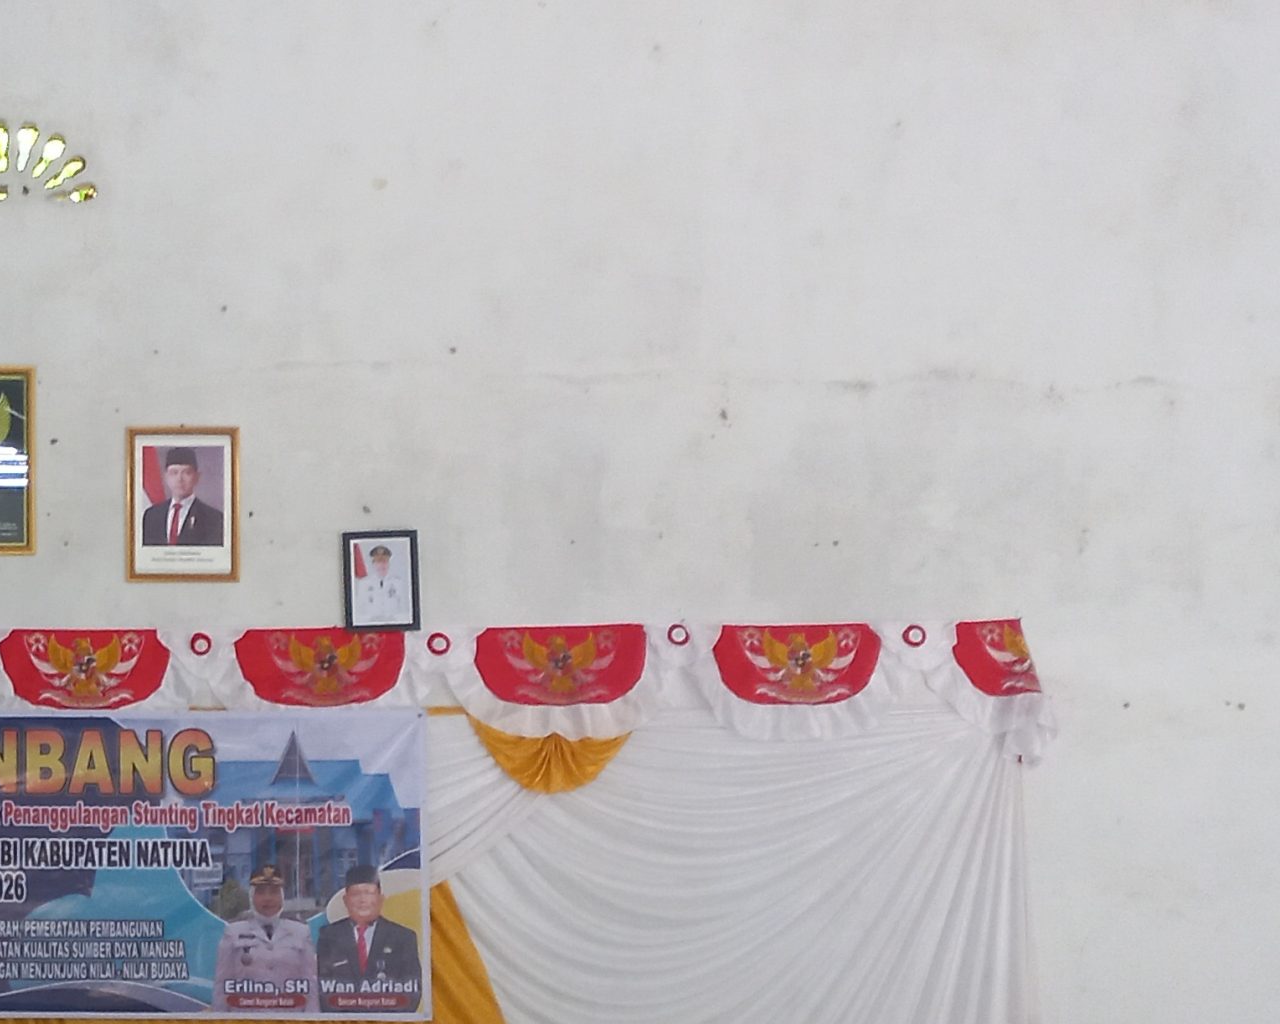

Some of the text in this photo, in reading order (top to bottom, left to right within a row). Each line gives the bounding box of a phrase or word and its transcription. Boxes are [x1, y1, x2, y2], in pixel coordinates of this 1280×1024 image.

[3, 800, 129, 832] Penanggulangan
[133, 801, 198, 832] Stunting
[201, 801, 261, 832] Tingkat
[264, 801, 352, 827] Kecamatan
[22, 838, 131, 869] KABUPATEN
[135, 839, 213, 869] NATUNA
[24, 920, 87, 937] PEMERATAAN
[90, 920, 163, 937] PEMBANGUNAN
[23, 941, 70, 958] KUALITAS
[72, 941, 112, 958] SUMBER
[114, 941, 139, 958] DAYA
[141, 941, 185, 958] MANUSIA
[21, 962, 87, 979] MENJUNJUNG
[89, 962, 115, 978] NILAI
[123, 963, 149, 979] NILAI
[151, 963, 189, 979] BUDAYA
[224, 980, 309, 995] Erlina, SH
[320, 980, 419, 993] Wan Adriadi
